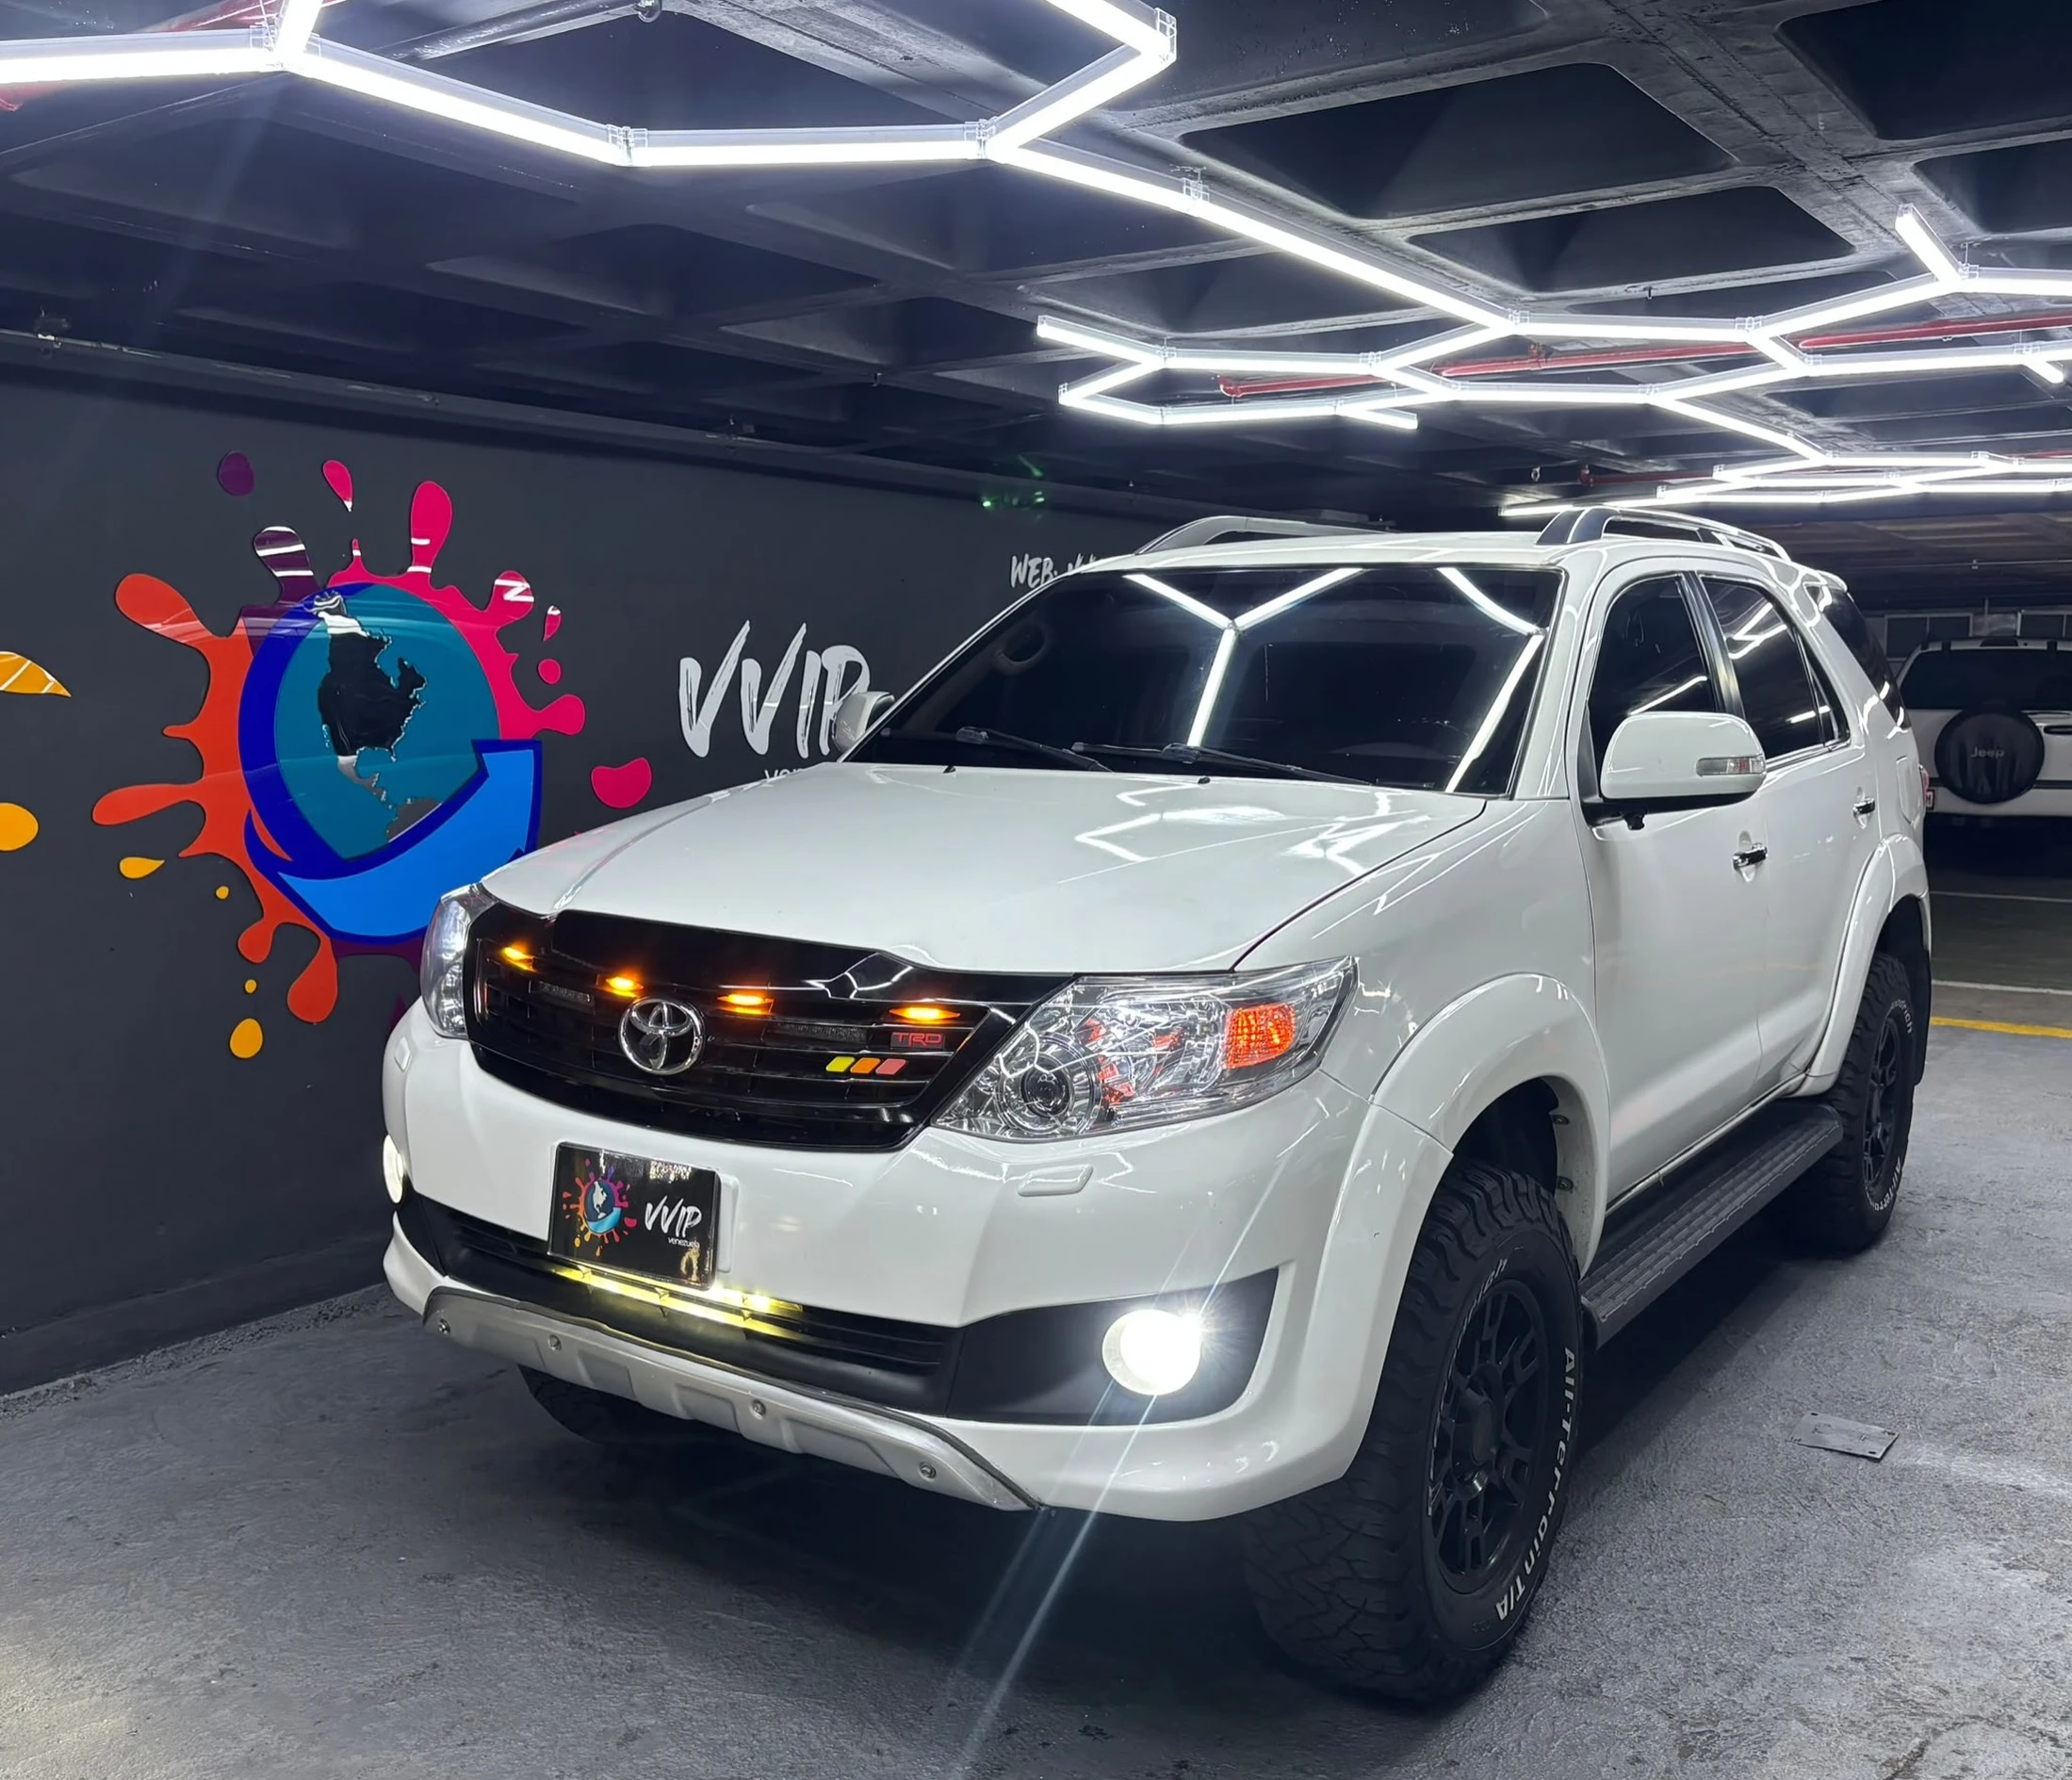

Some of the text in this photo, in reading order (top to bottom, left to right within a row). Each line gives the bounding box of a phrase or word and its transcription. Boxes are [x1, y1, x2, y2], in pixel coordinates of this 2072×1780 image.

[678, 619, 871, 759] VVIP
[1970, 745, 2005, 759] Jeep
[896, 1032, 942, 1048] TRD
[644, 1195, 702, 1238] VVIP
[1495, 1575, 1525, 1621] T/A
